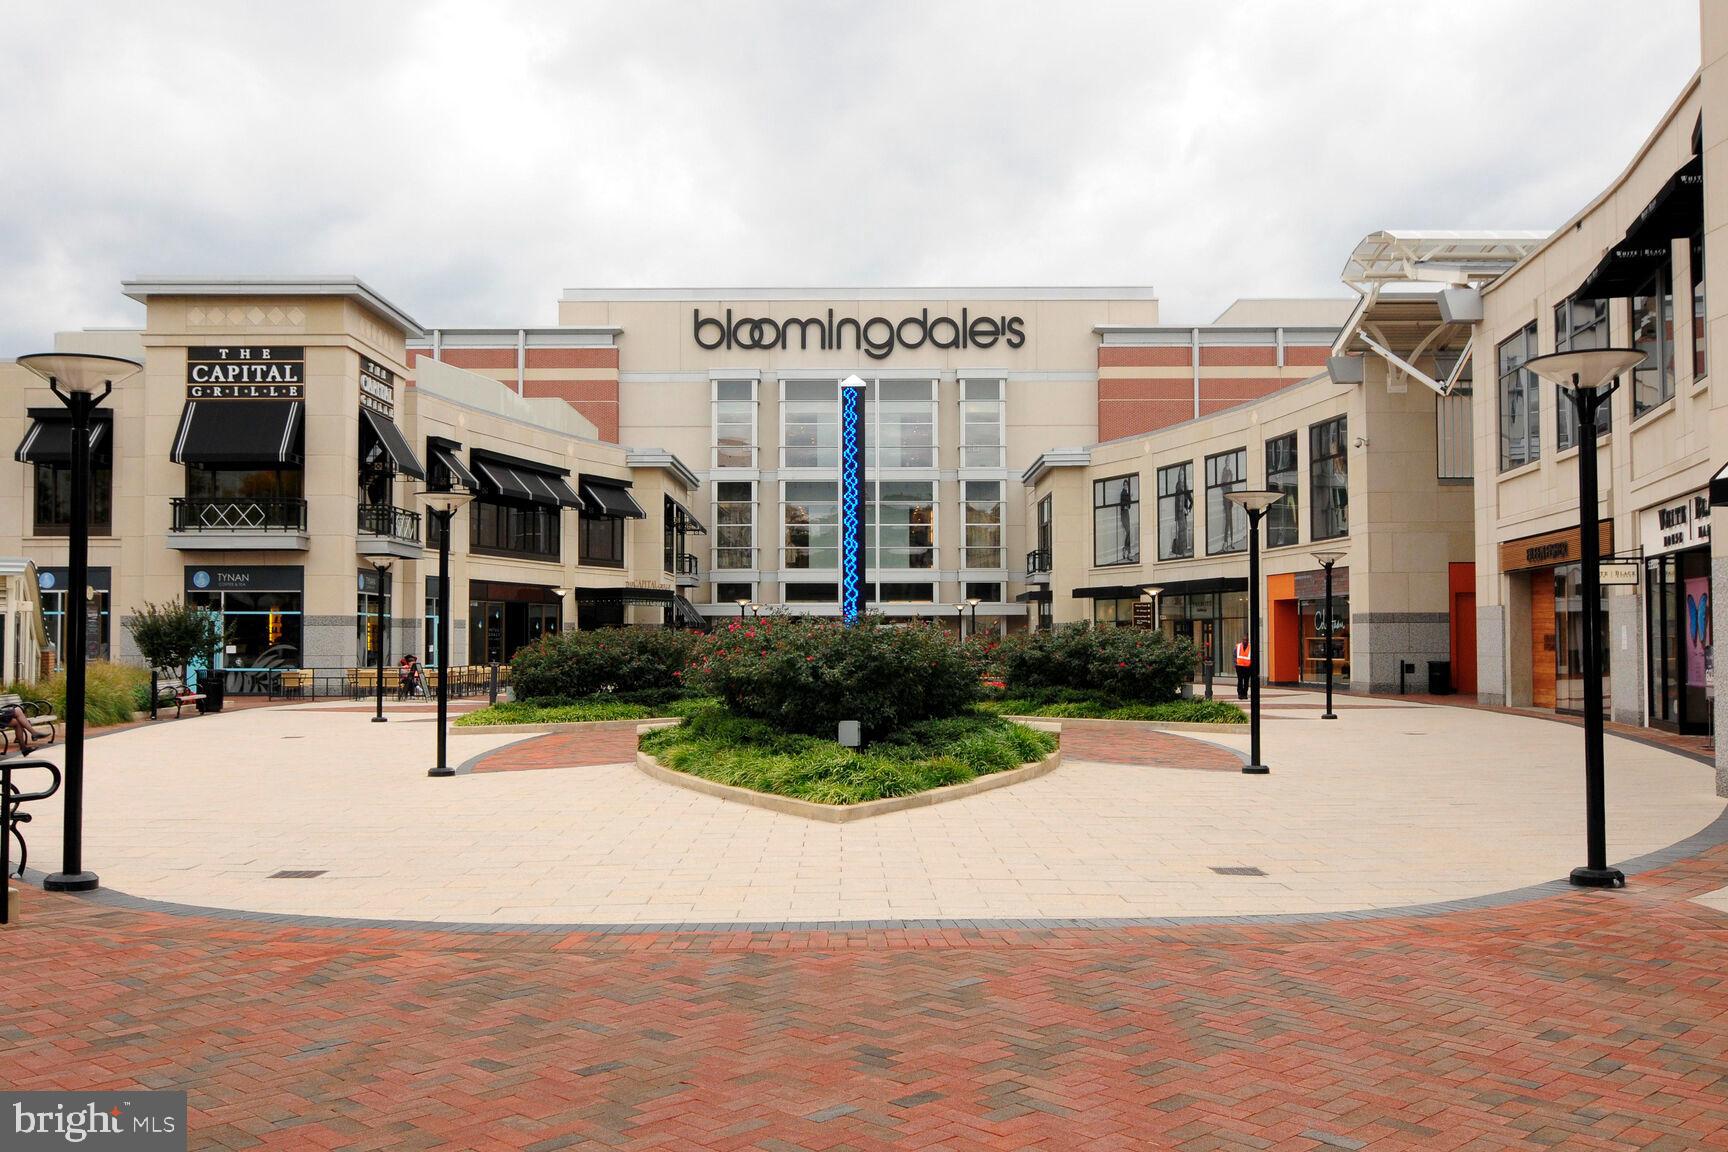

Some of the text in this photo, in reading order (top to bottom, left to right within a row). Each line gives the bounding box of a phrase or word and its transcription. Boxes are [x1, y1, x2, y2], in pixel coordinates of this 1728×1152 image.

[694, 308, 1026, 360] bloomingdale's
[219, 348, 271, 359] THE
[192, 364, 298, 382] CAPITAL
[217, 573, 249, 582] TYNAN
